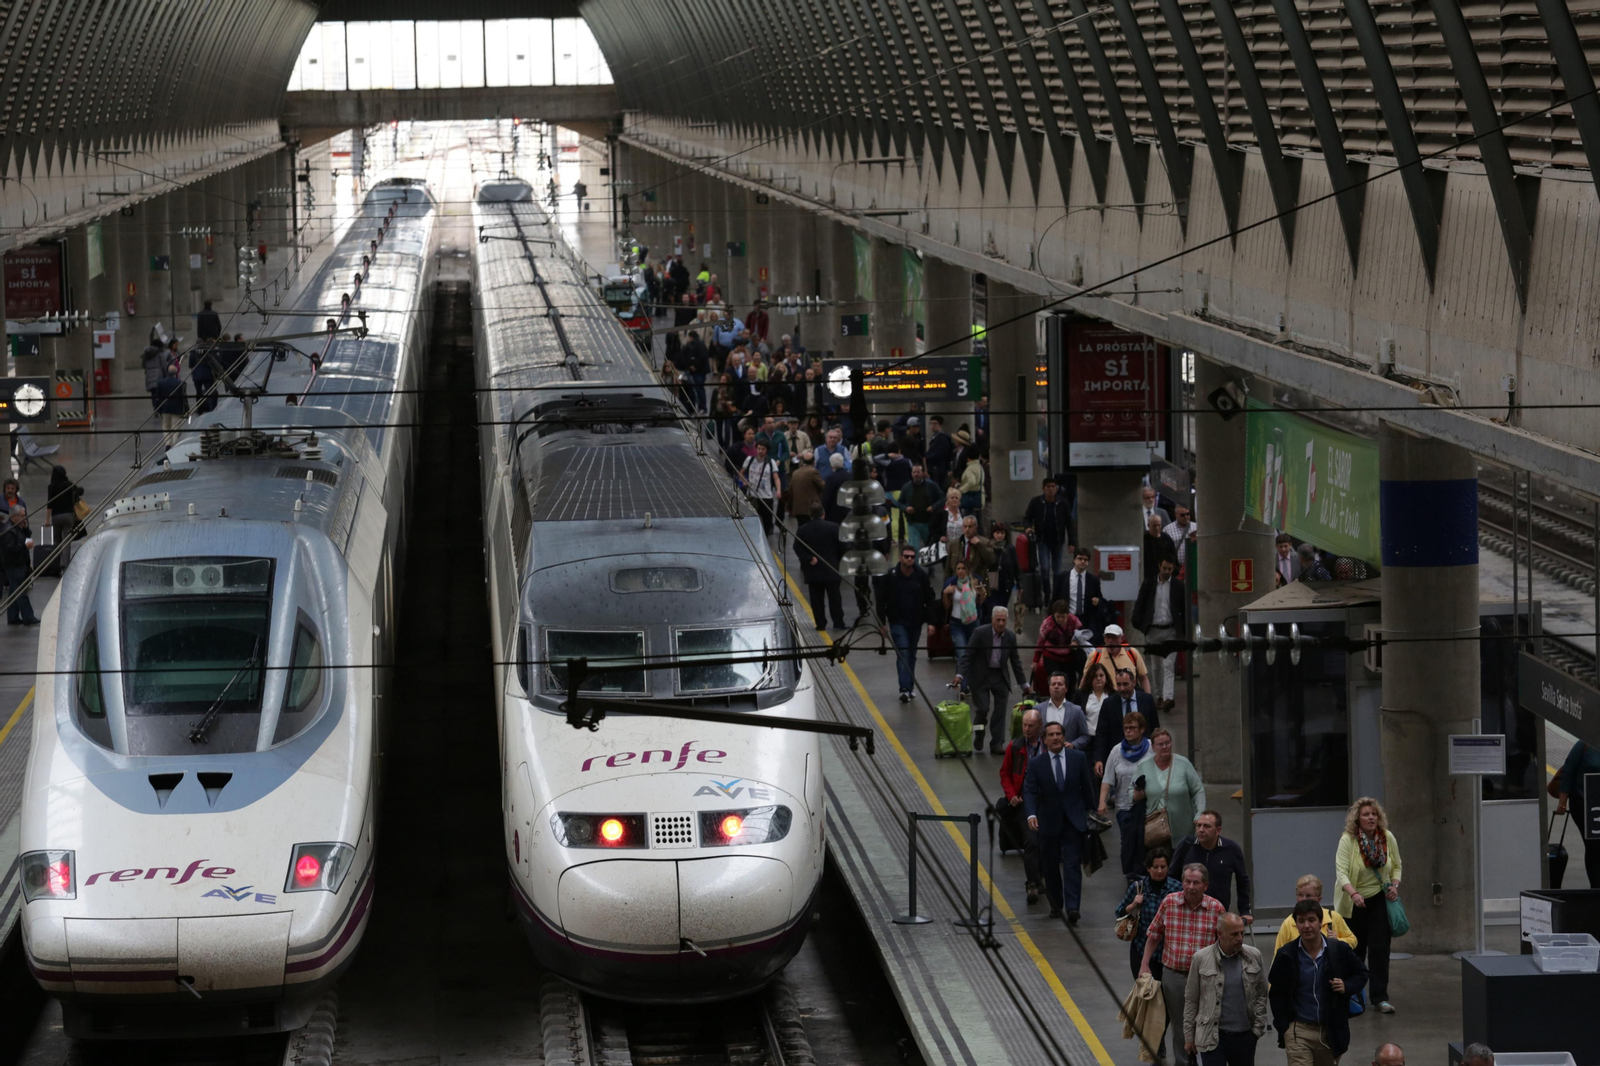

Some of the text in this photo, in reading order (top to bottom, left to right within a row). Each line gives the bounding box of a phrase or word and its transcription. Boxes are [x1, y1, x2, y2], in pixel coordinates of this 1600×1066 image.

[21, 265, 36, 279] SÍ
[841, 324, 849, 336] 3
[31, 344, 39, 355] 4
[1079, 341, 1155, 352] LA PRÓSTATA
[1105, 354, 1129, 376] SÍ
[957, 378, 969, 396] 3
[1084, 380, 1150, 391] IMPORTA
[1327, 446, 1334, 485] EL
[1541, 681, 1582, 720] Sevilla Santa Justa
[581, 740, 728, 772] renfe
[692, 778, 771, 801] AVE
[84, 858, 236, 886] renfe
[200, 884, 277, 905] AVE
